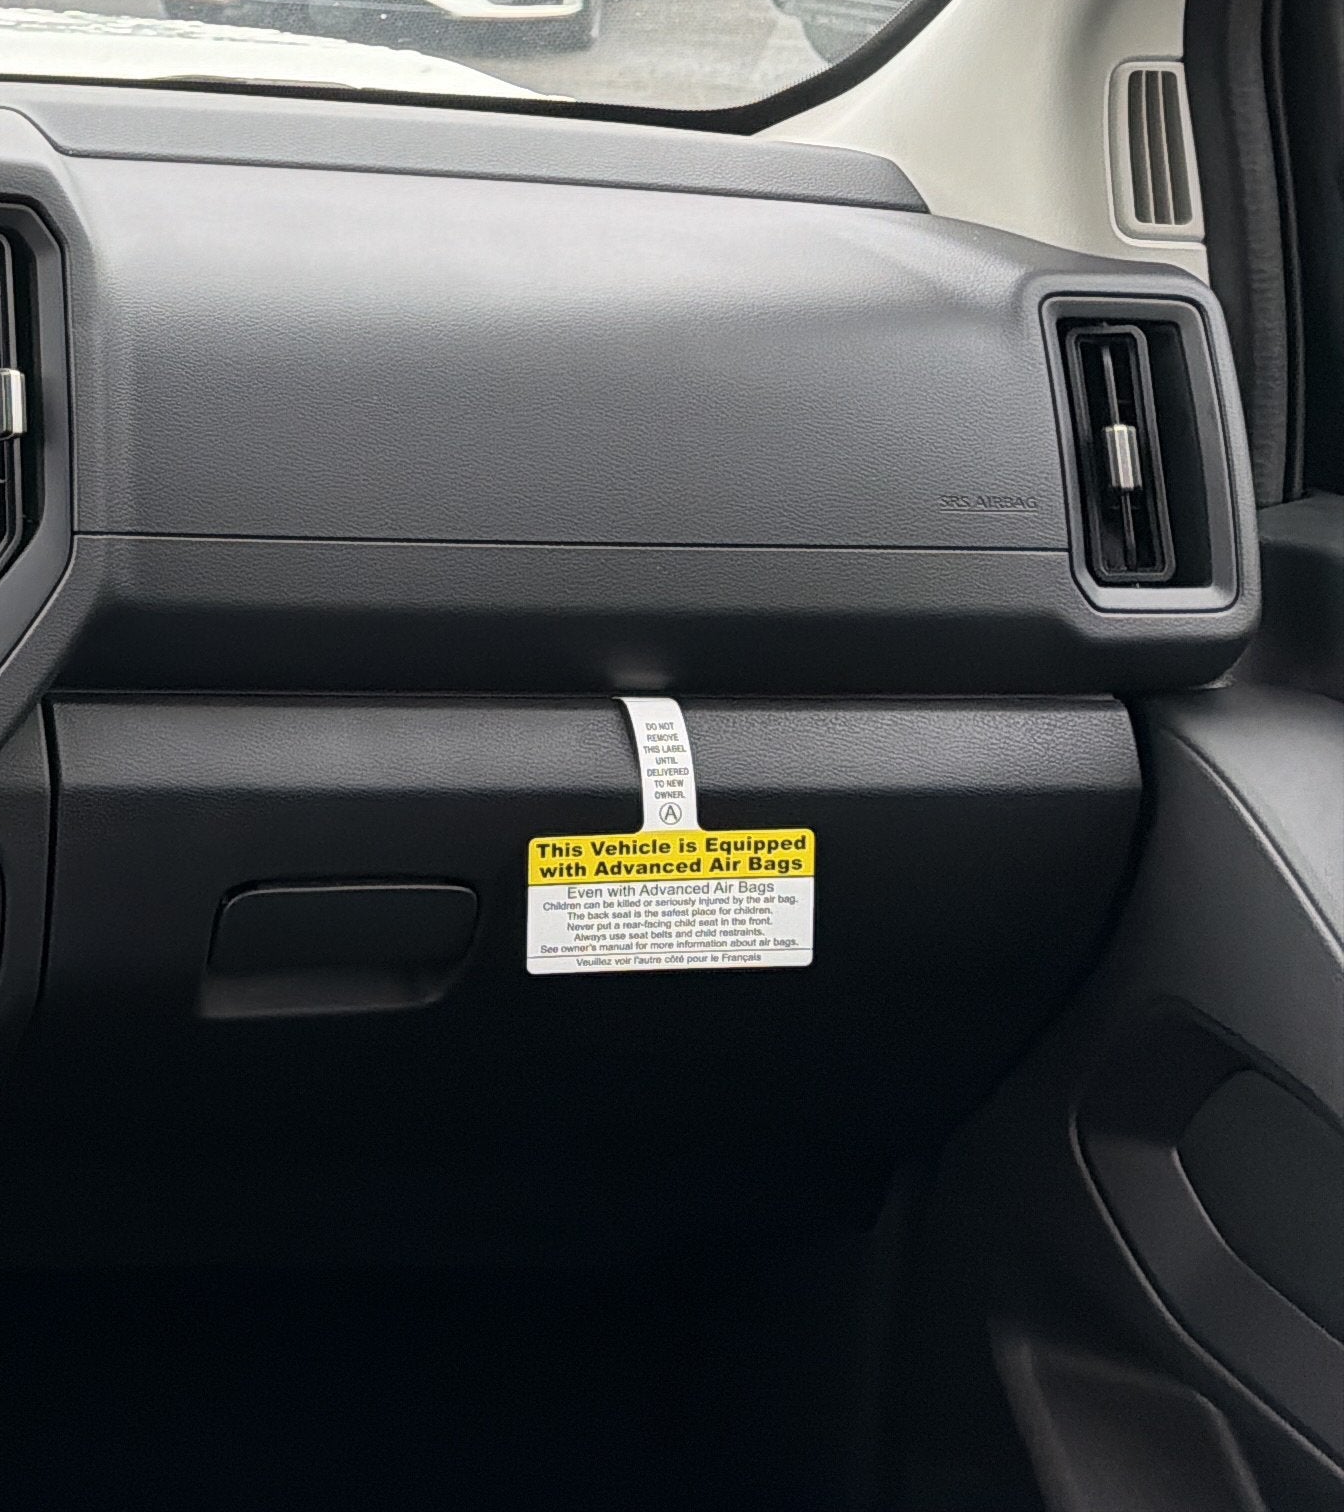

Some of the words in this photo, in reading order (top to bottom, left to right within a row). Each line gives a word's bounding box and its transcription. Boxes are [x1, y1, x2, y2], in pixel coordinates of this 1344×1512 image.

[939, 495, 970, 508] SRS
[976, 495, 1037, 509] AIRBAG
[536, 843, 583, 858] This
[590, 839, 671, 856] Vehicle
[679, 838, 697, 853] is
[705, 835, 806, 855] Equipped
[539, 862, 586, 878] with
[594, 858, 701, 876] Advanced
[709, 857, 741, 872] Air
[749, 857, 803, 874] Bags
[567, 886, 603, 899] Even
[608, 885, 635, 897] with
[640, 882, 709, 896] Advanced
[714, 881, 733, 894] Air
[738, 881, 774, 895] Bags
[543, 902, 581, 911] Children
[617, 900, 640, 908] killed
[655, 897, 696, 907] seriously
[733, 896, 743, 906] by
[746, 895, 761, 904] the
[567, 912, 585, 920] The
[588, 911, 609, 919] back
[612, 910, 631, 918] seat
[634, 910, 641, 918] is
[644, 909, 658, 917] the
[661, 908, 689, 917] safest
[692, 907, 716, 917] place
[719, 907, 731, 915] for
[574, 933, 606, 942] Always
[629, 931, 648, 939] seat
[651, 930, 672, 939] belts
[675, 929, 692, 937] and
[695, 929, 716, 937] child
[540, 946, 558, 954] See
[600, 943, 633, 951] manual
[650, 941, 674, 949] more
[677, 940, 727, 948] information
[730, 939, 756, 947] about
[576, 957, 612, 966] Veuillez
[615, 957, 631, 965] voir
[687, 955, 707, 964] pour
[711, 954, 719, 962] le
[722, 953, 762, 963] Français
